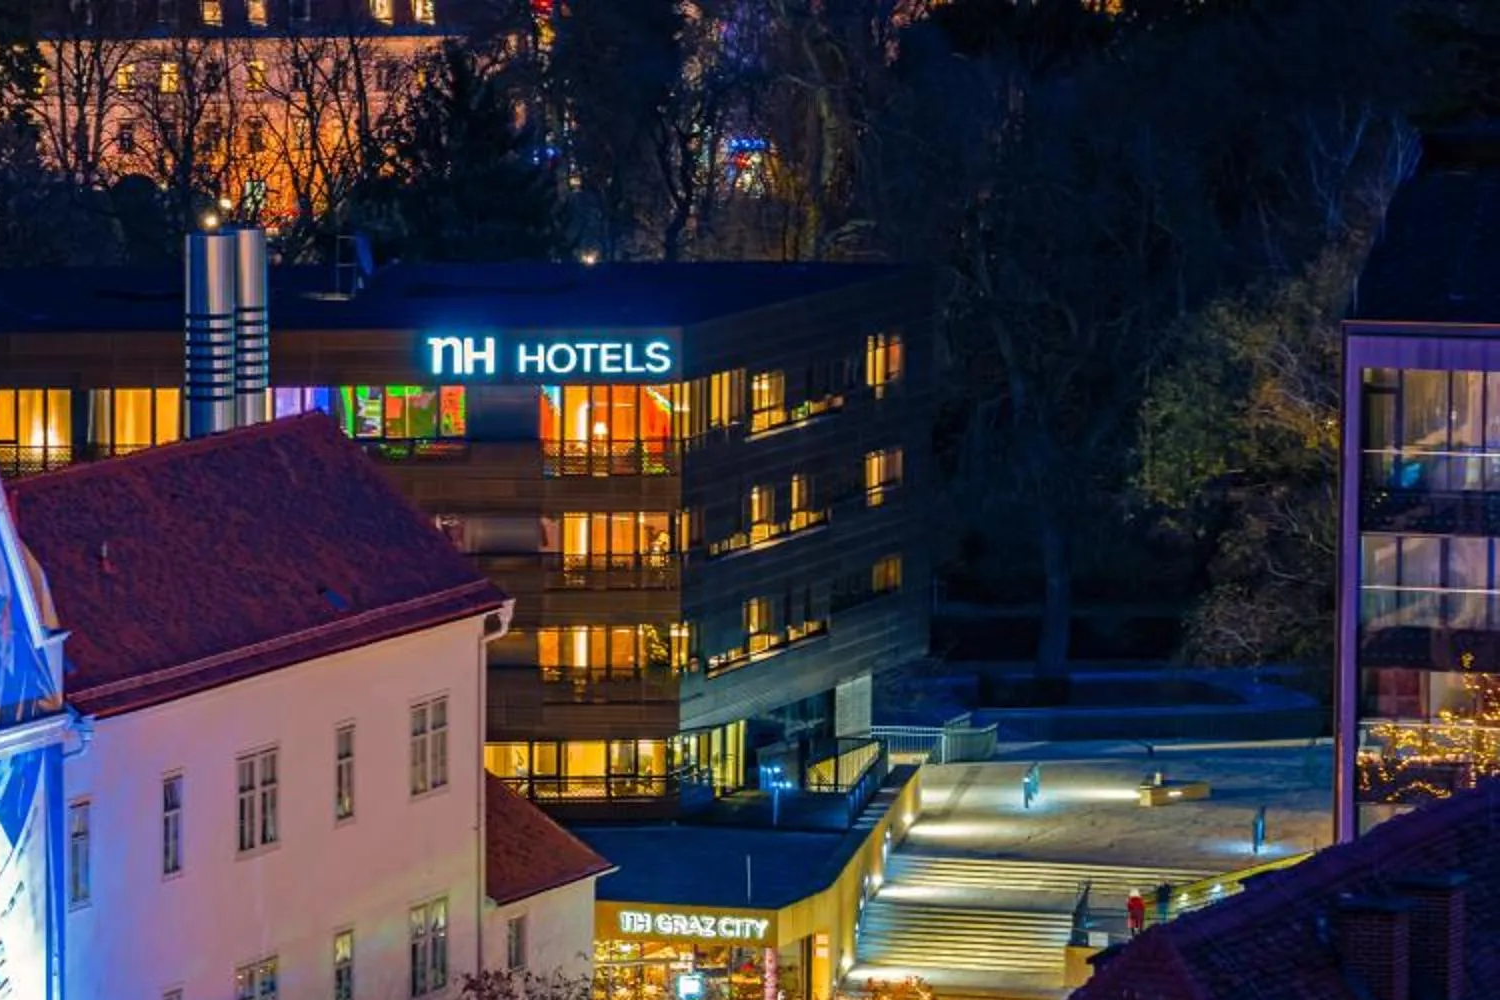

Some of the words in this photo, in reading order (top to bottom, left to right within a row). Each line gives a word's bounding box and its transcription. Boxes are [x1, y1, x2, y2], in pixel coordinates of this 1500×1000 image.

[518, 341, 672, 373] HOTELS
[655, 913, 717, 938] GRAZ
[717, 917, 769, 940] CITY
